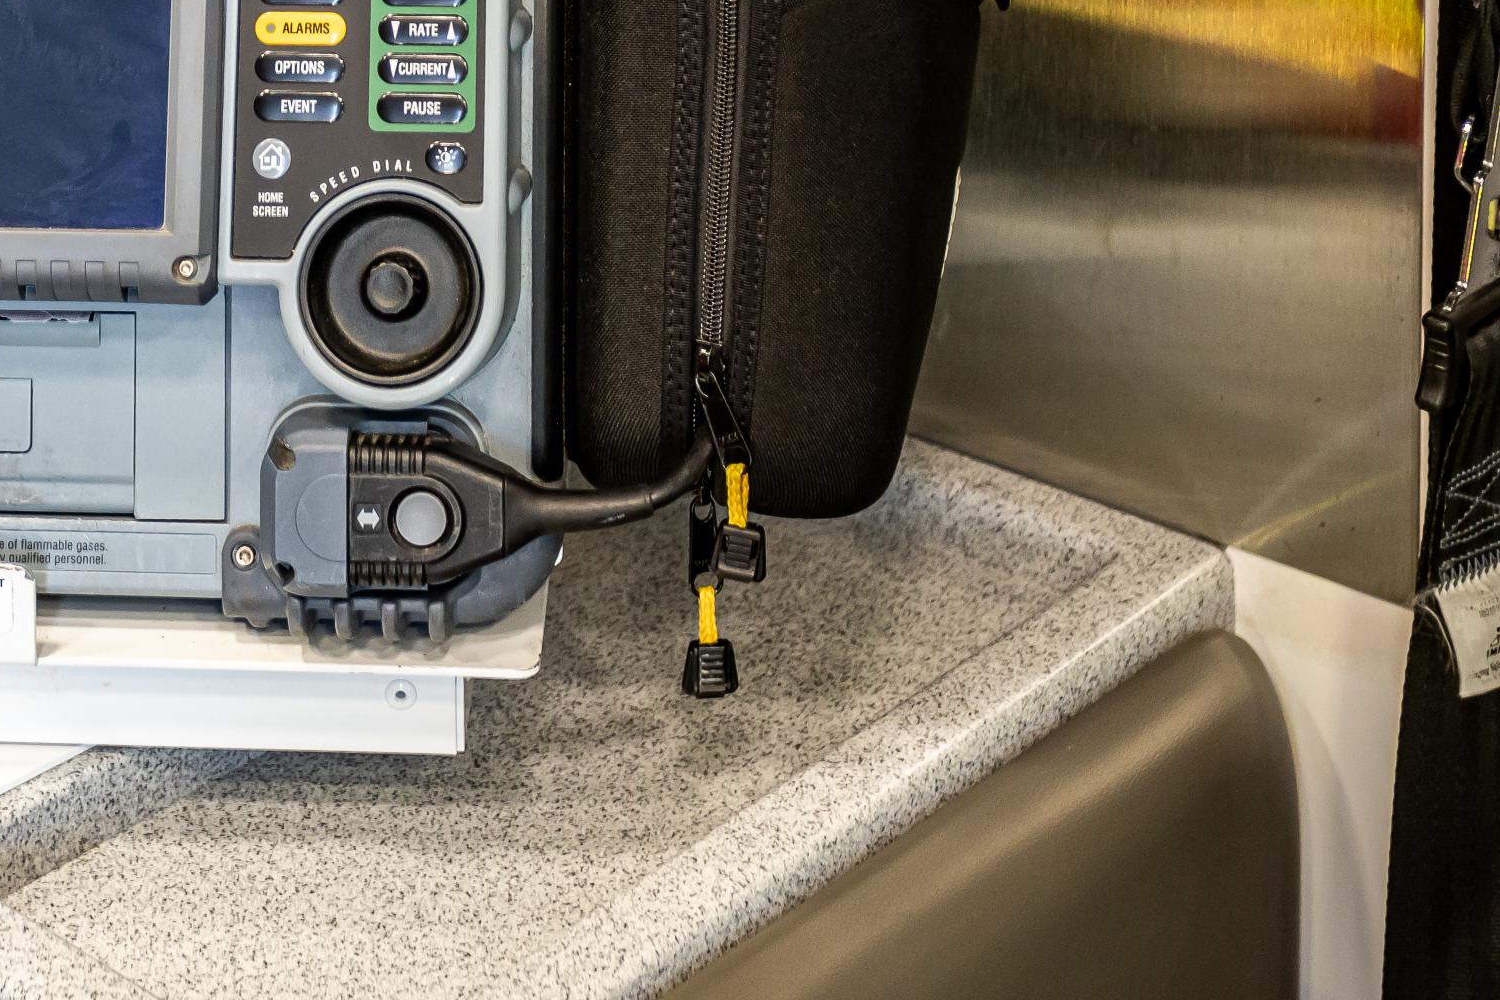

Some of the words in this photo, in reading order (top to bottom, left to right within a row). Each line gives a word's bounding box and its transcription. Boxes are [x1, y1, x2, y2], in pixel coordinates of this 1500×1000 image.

[282, 22, 331, 35] ALARMS
[408, 23, 439, 37] RATE
[274, 60, 325, 75] OPTIONS
[397, 62, 448, 76] CURRENT
[280, 100, 317, 114] EVENT
[403, 101, 441, 115] PAUSE
[309, 165, 360, 204] SPEED
[372, 159, 414, 173] DIAL
[257, 191, 284, 204] HOME
[252, 205, 289, 218] SCREEN
[7, 538, 18, 550] of
[20, 538, 74, 551] flammable
[76, 540, 108, 554] gases.
[8, 551, 51, 564] qualified
[53, 553, 107, 567] personnel.
